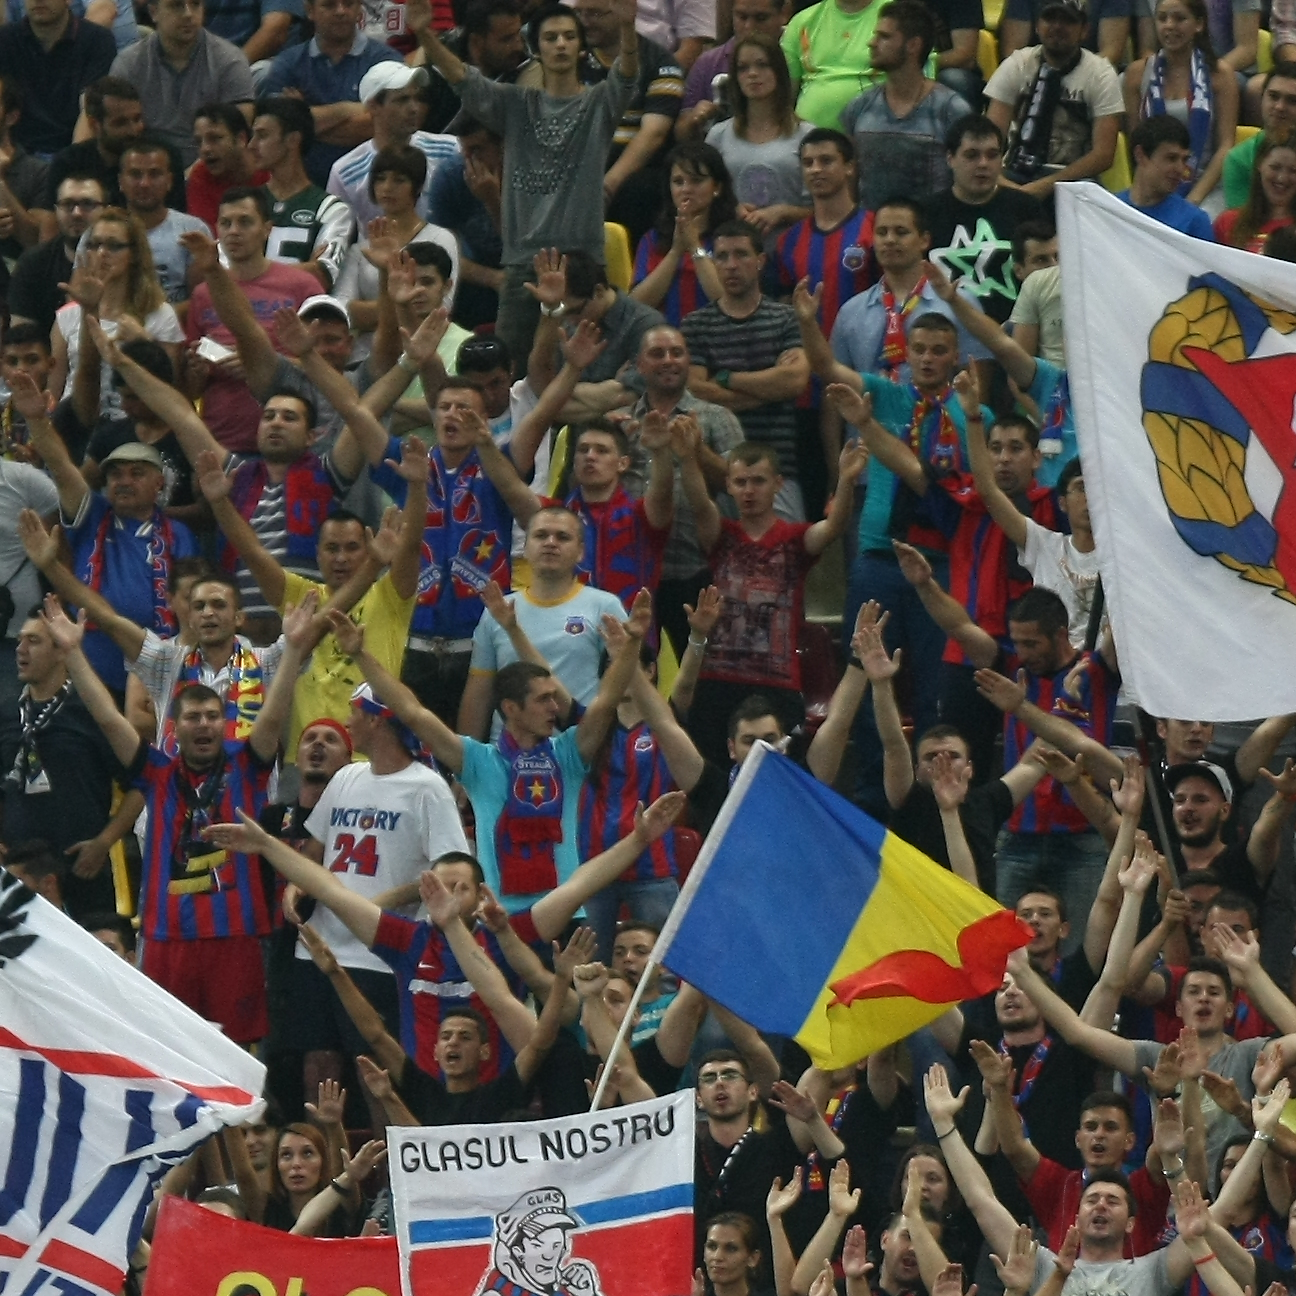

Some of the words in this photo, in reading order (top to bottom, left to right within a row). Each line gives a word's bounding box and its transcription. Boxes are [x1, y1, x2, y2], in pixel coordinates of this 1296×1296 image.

[331, 832, 379, 878] 24
[399, 1131, 530, 1175] GLASUL
[540, 1107, 677, 1165] NOSTRU
[527, 1192, 561, 1207] GLAS
